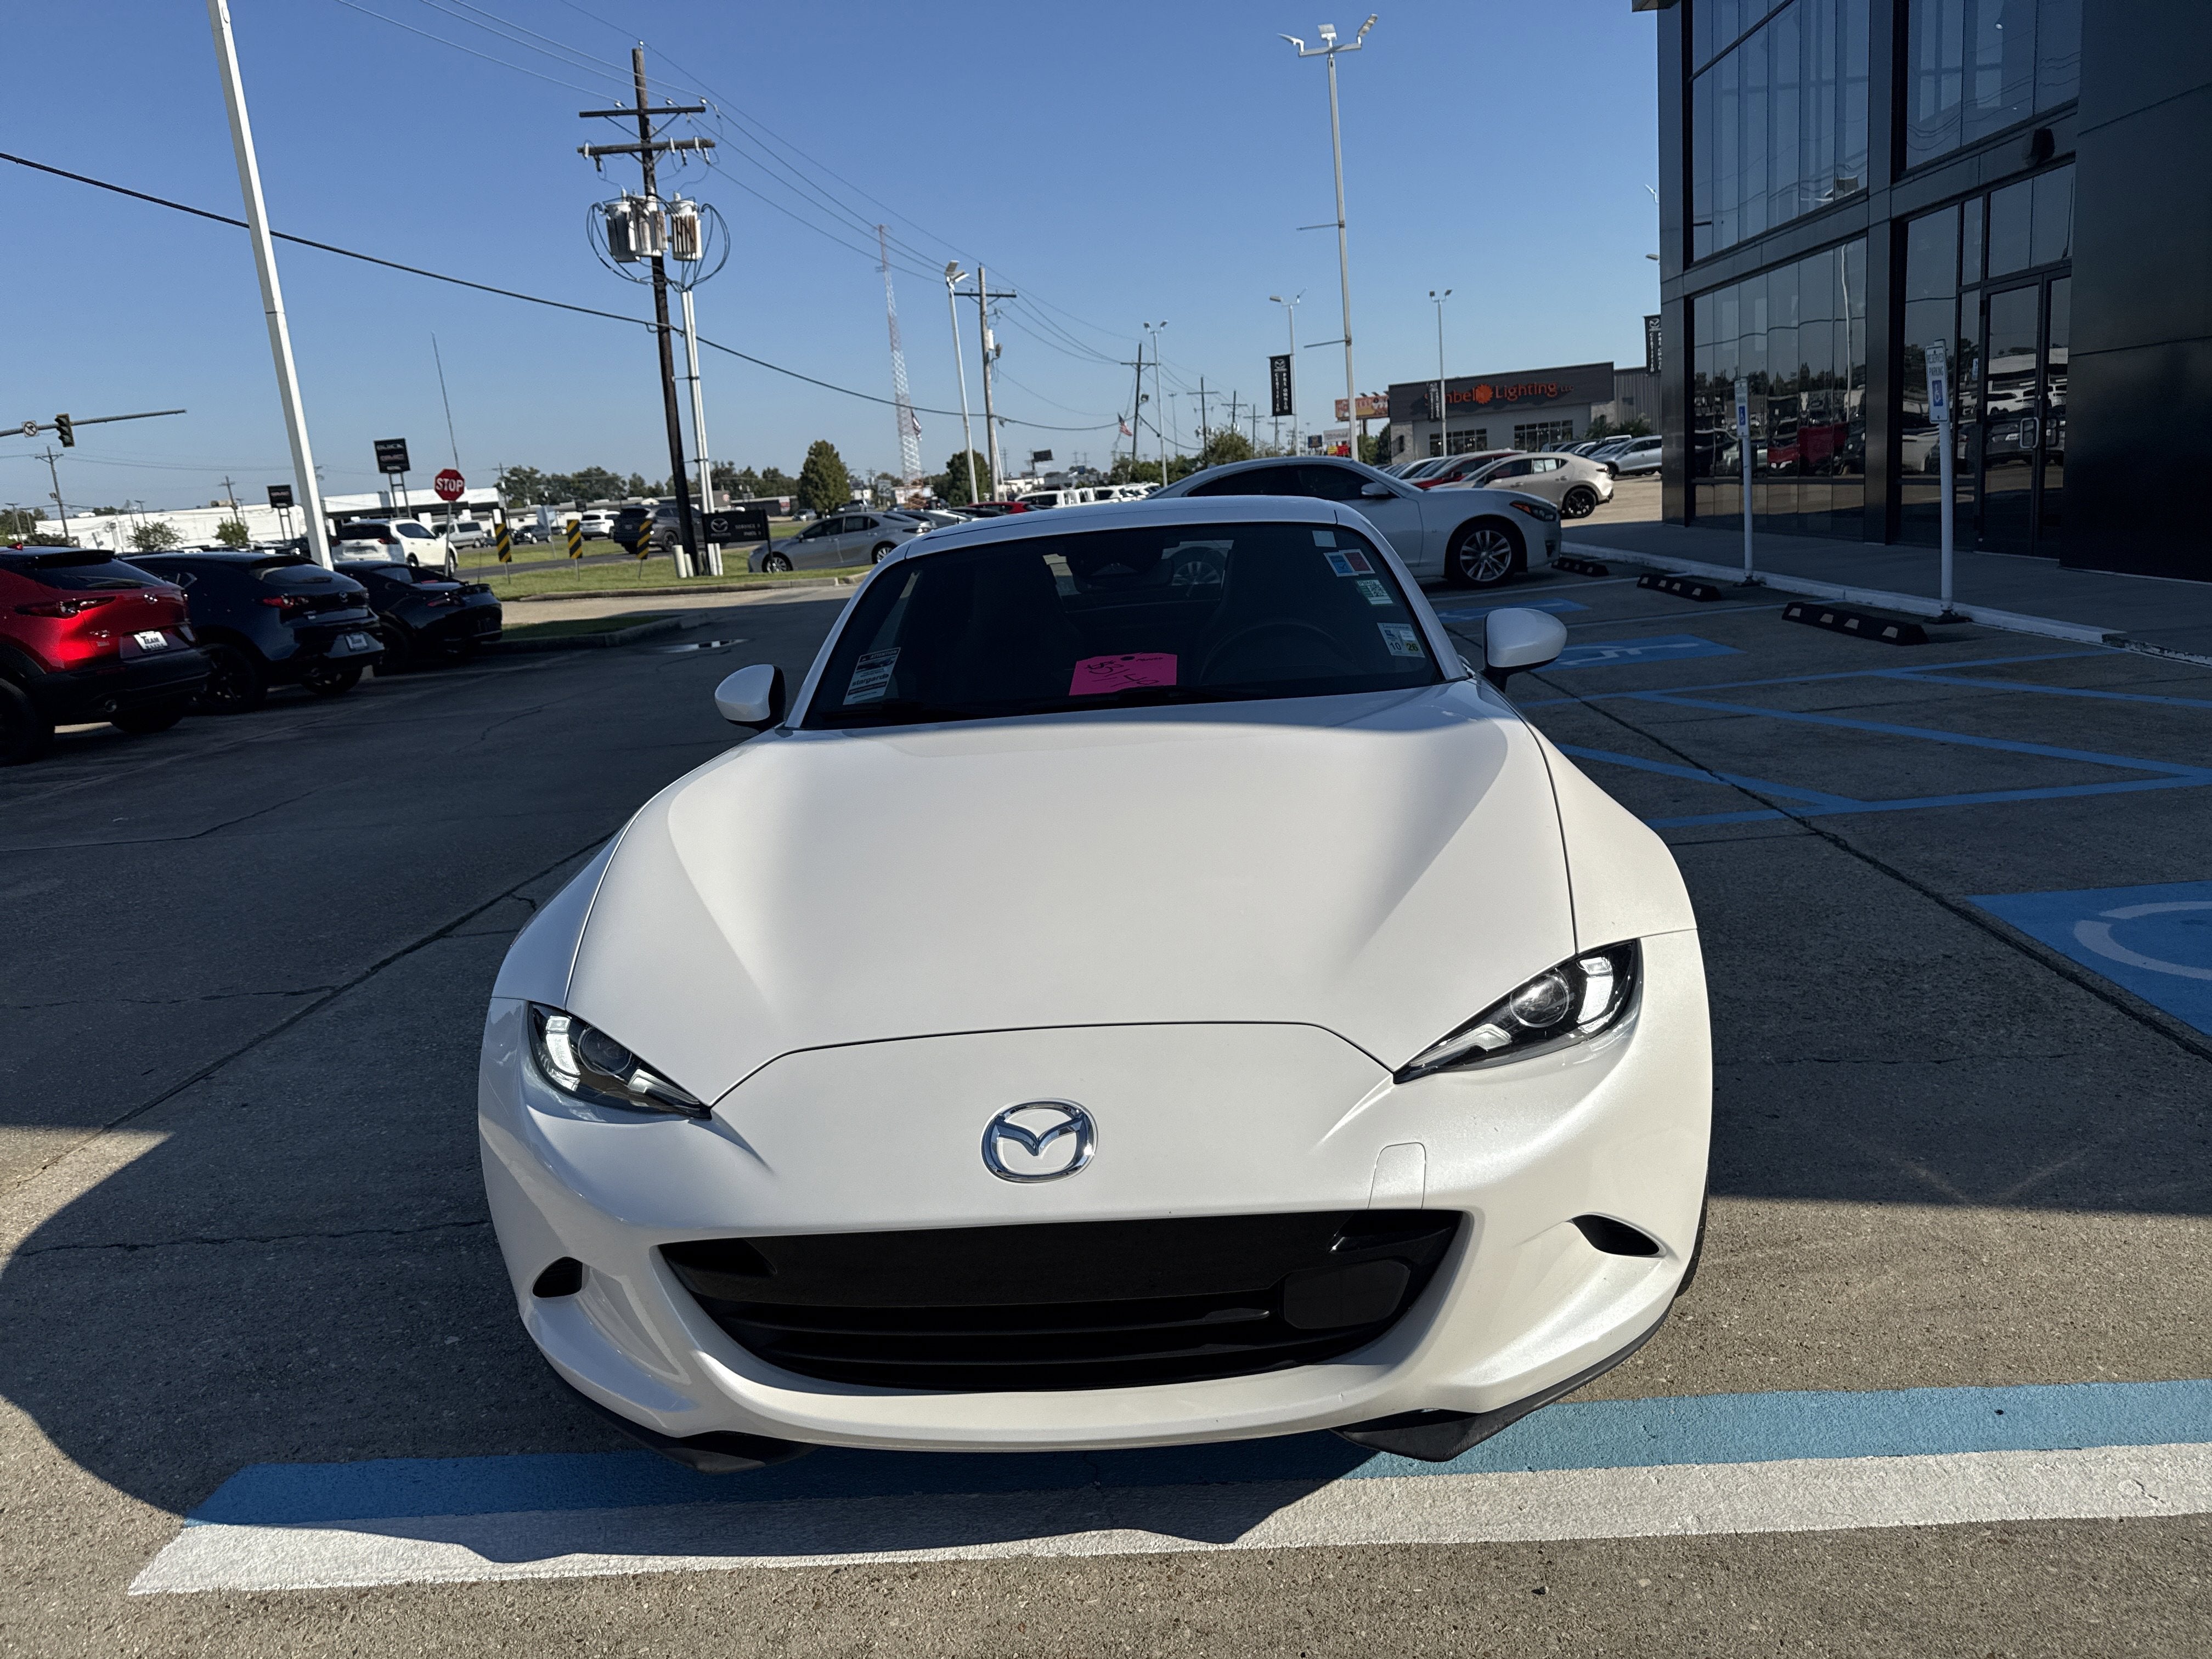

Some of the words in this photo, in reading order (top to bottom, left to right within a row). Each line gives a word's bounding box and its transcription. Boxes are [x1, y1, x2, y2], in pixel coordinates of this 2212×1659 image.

[1929, 366, 1944, 376] PARKING
[1424, 388, 1476, 406] nbel
[1495, 382, 1558, 402] Lighting
[436, 478, 464, 492] STOP
[1406, 643, 1419, 651] 26
